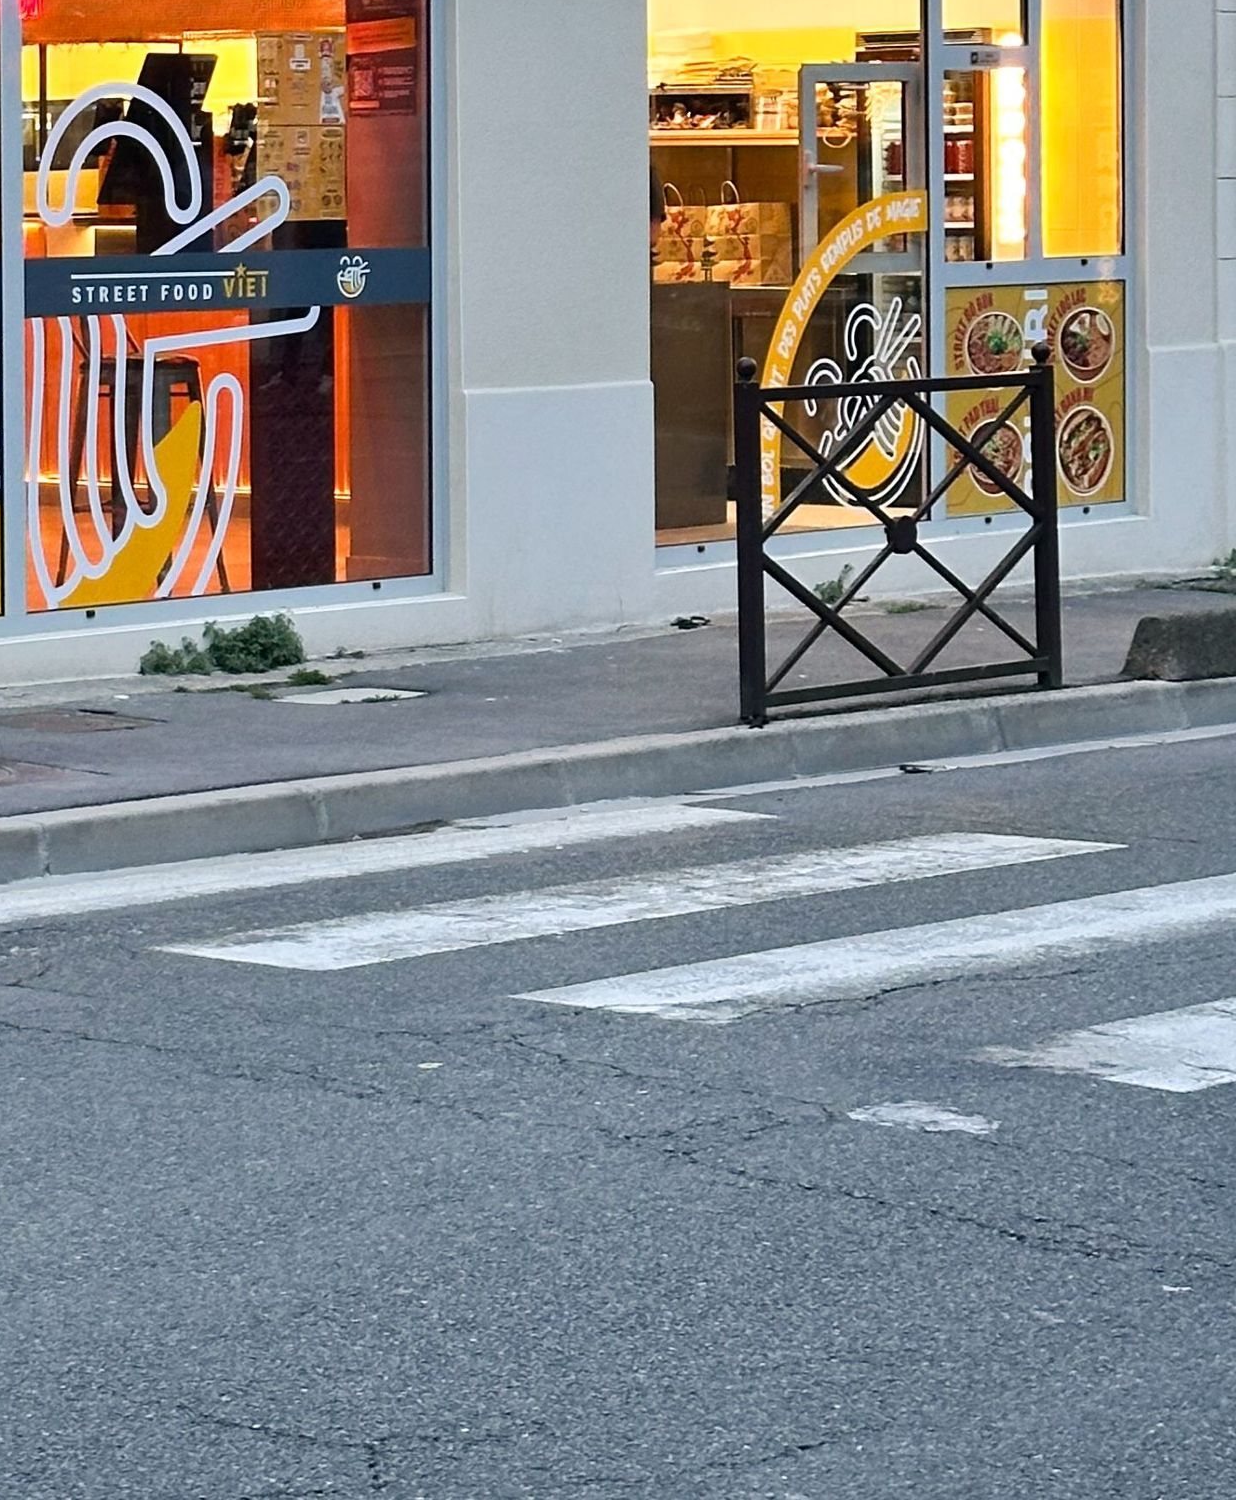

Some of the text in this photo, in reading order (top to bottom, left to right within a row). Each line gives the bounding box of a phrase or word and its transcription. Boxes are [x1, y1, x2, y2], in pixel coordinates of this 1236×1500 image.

[71, 273, 269, 304] STREET FOOD VIET
